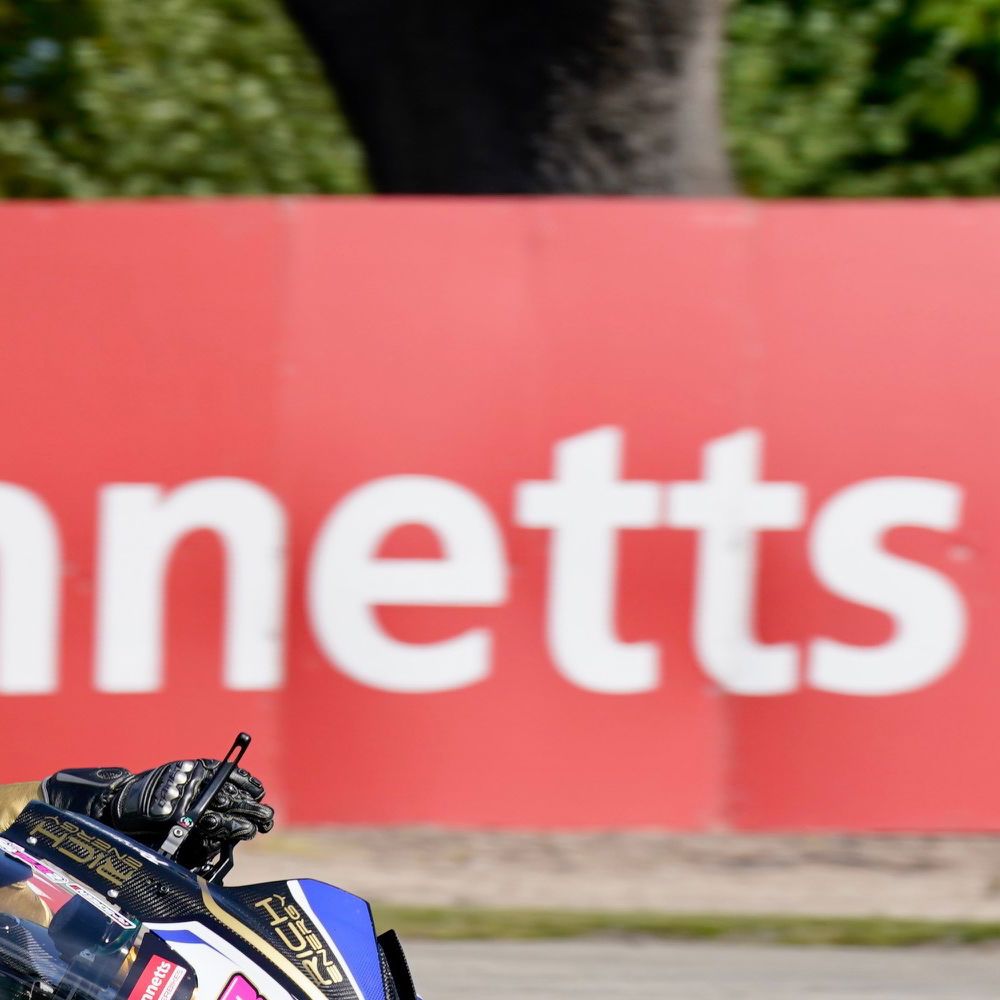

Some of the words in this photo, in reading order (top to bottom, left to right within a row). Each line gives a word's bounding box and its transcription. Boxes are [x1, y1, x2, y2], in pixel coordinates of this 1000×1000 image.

[30, 820, 134, 886] RICH
[255, 897, 333, 986] RICH
[273, 894, 343, 984] ENERGY
